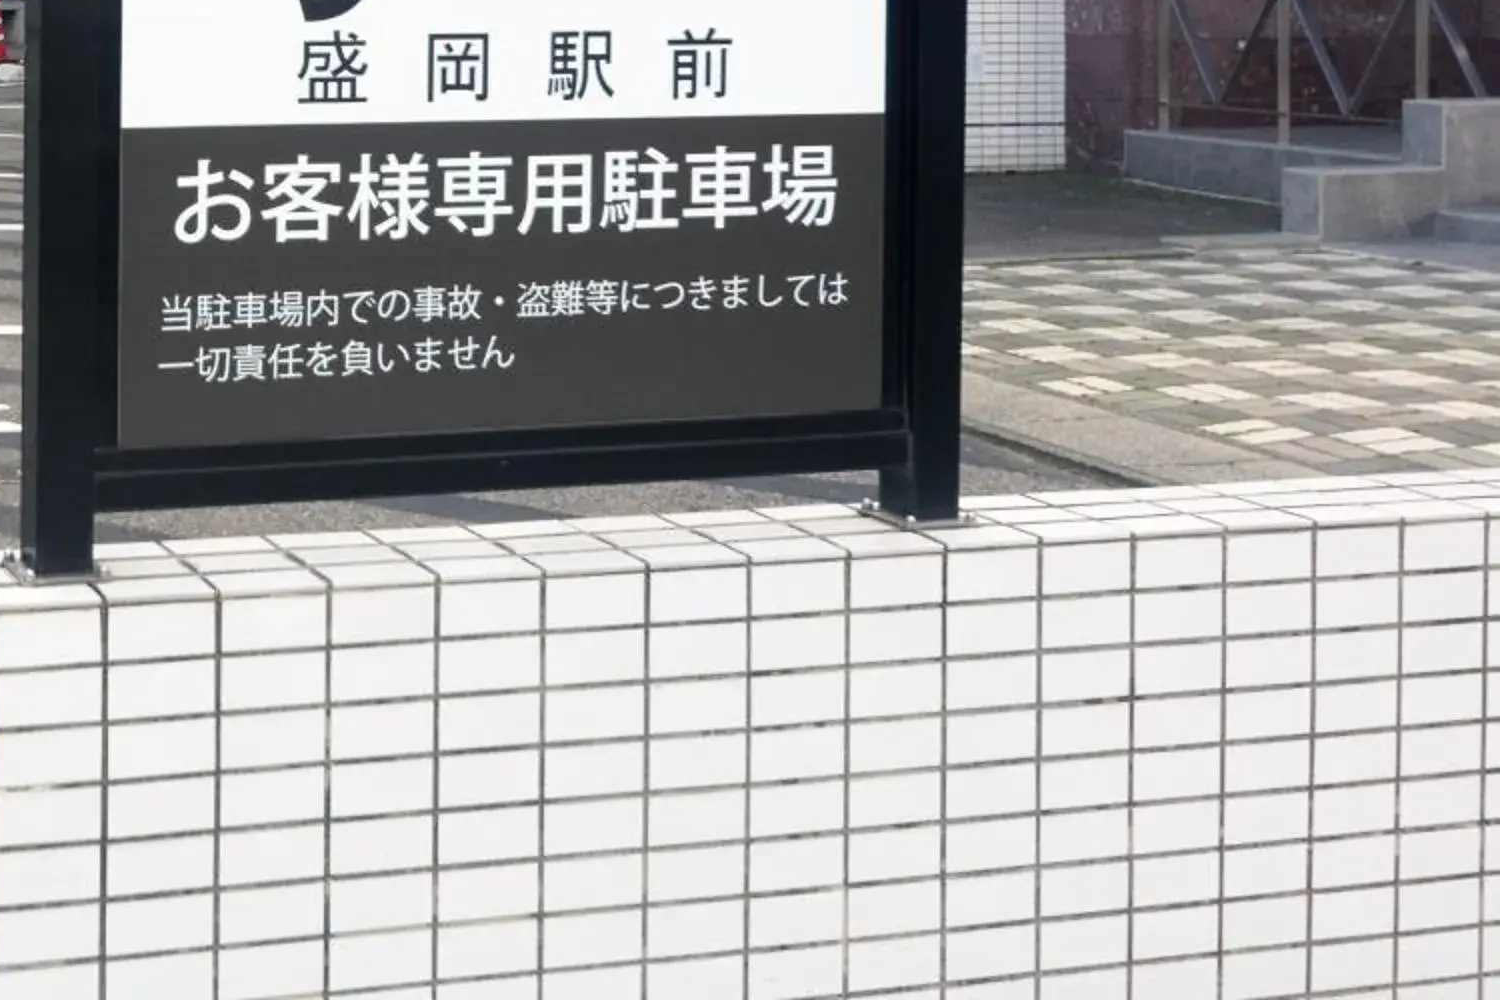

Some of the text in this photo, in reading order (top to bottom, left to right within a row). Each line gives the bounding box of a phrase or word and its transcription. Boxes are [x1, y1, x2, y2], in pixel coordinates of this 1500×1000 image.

[297, 27, 733, 104] 盛岡駅前
[173, 142, 839, 245] お客様専用駐車場
[160, 271, 849, 333] 当駐車場内での事故・盗難等につきましては
[157, 334, 516, 383] 一切責任を負いません
